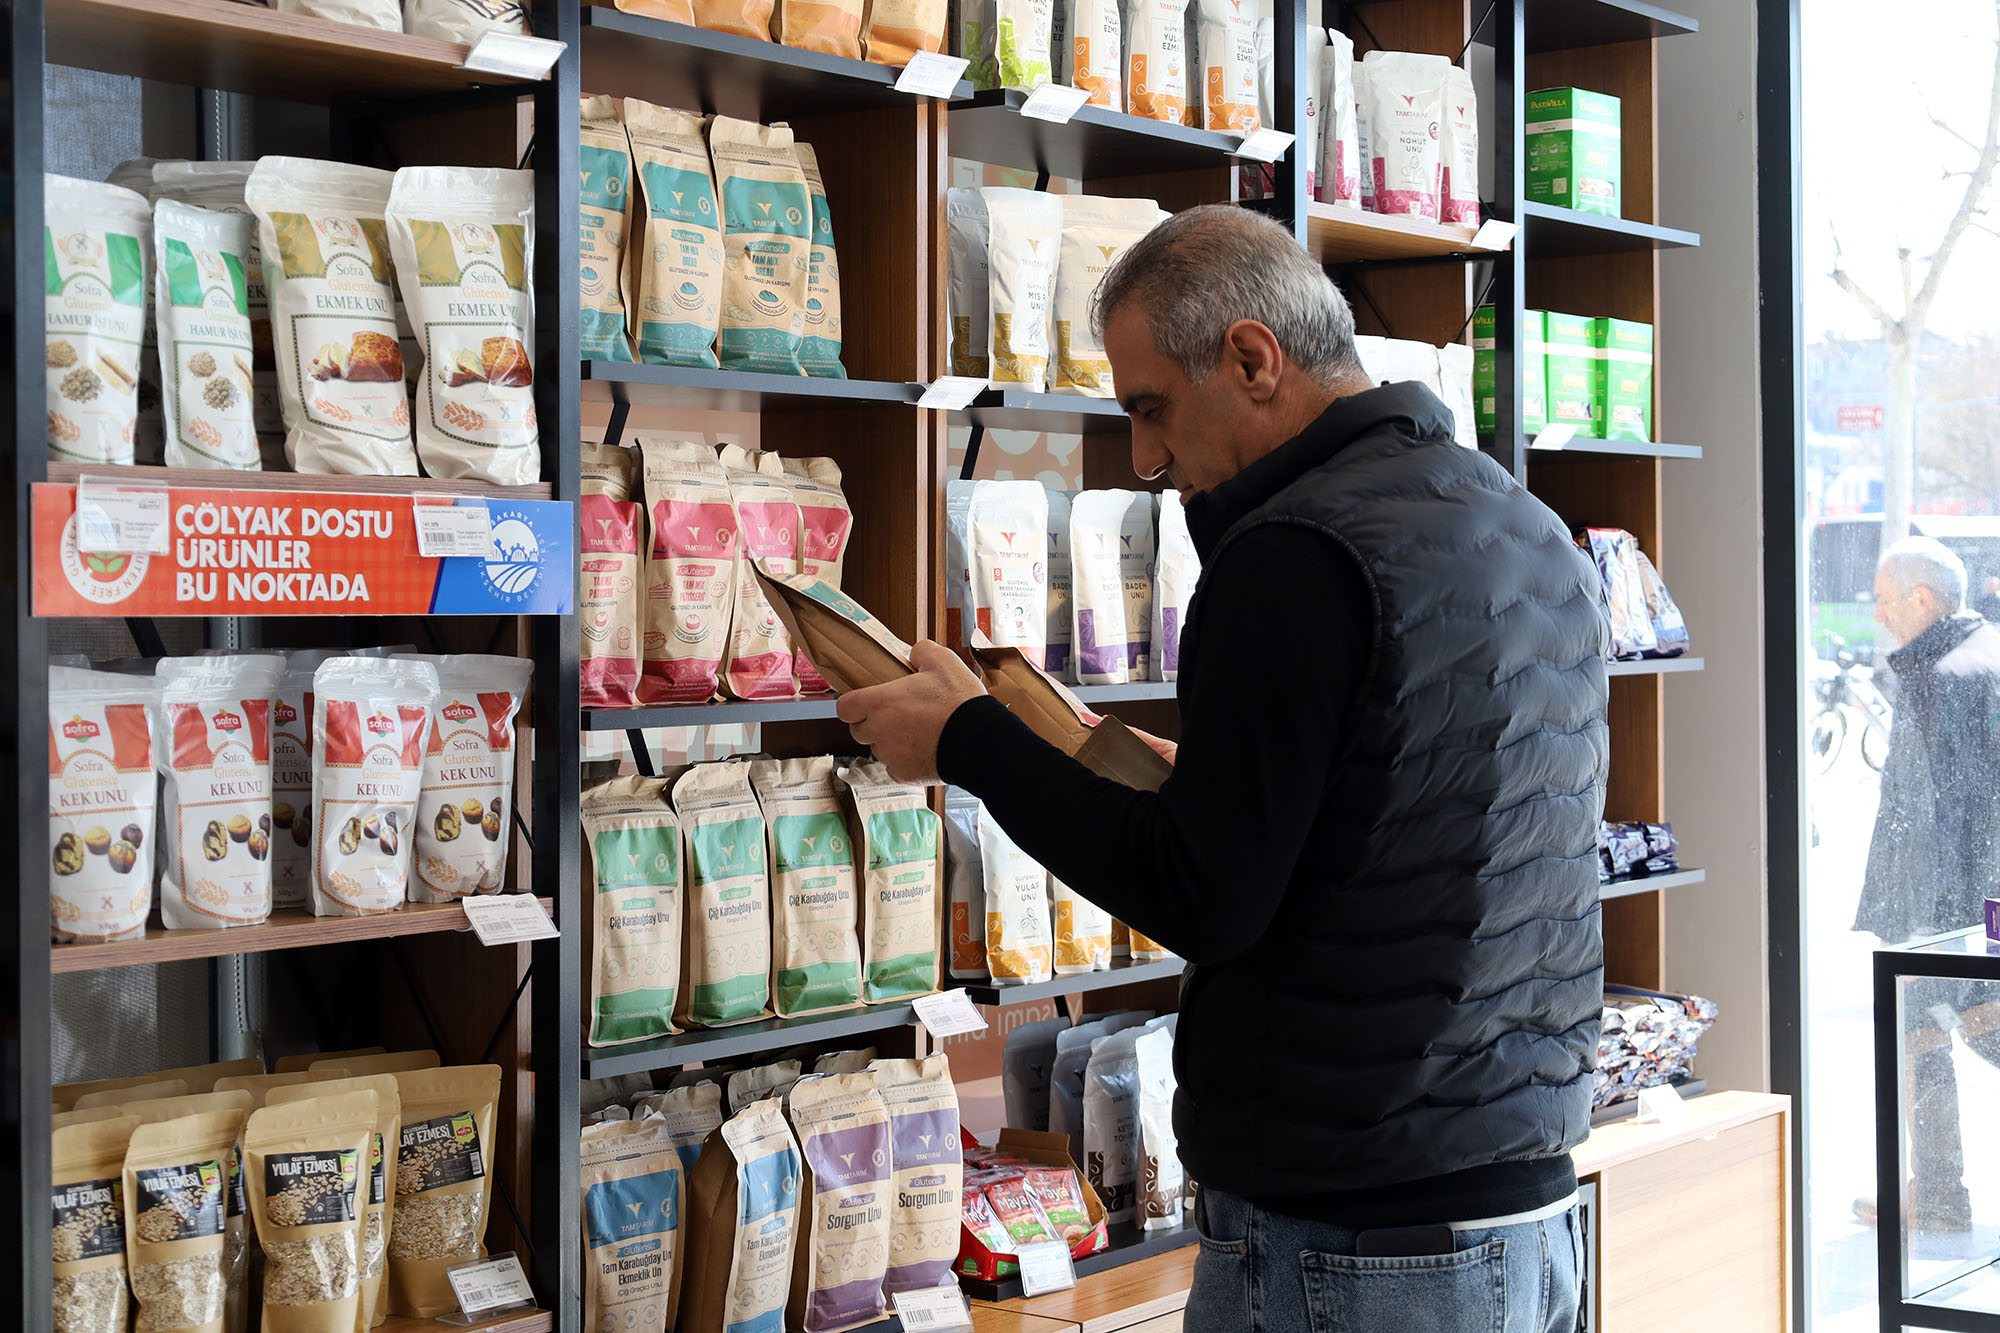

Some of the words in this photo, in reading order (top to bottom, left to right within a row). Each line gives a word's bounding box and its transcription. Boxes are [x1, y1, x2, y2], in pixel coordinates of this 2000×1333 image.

[1400, 137, 1427, 145] NOHUT
[1406, 145, 1423, 153] UNU
[336, 263, 365, 277] Sofra
[471, 271, 497, 284] Sofra
[316, 295, 364, 311] EKMEK
[367, 297, 388, 313] UNU
[448, 303, 497, 317] EKMEK
[500, 304, 519, 318] UNU
[175, 502, 293, 538] ÇÖLYAK
[301, 507, 393, 538] DOSTU
[491, 511, 534, 526] SAKARYA
[176, 538, 312, 569] ÜRÜNLER
[995, 568, 1001, 577] 6
[176, 571, 217, 602] BU
[227, 572, 370, 604] NOKTADA
[1125, 582, 1147, 590] BADEM
[1131, 591, 1145, 599] UNU
[445, 706, 473, 718] sofra
[65, 722, 96, 734] sofra
[215, 716, 240, 727] sofra
[368, 719, 393, 730] sofra
[274, 743, 296, 755] ofra
[453, 740, 479, 751] Sofra
[222, 751, 246, 764] Sofra
[372, 754, 393, 766] Sofra
[74, 759, 103, 773] Sofra
[440, 768, 467, 782] KEK
[470, 766, 496, 779] UNU
[210, 782, 236, 796] KEK
[238, 780, 263, 794] UNU
[357, 783, 379, 796] KEK
[382, 783, 403, 797] UNU
[60, 792, 91, 807] KEK
[95, 789, 128, 803] UNU
[880, 890, 891, 903] Çiğ
[891, 884, 924, 900] Karabuğday
[1015, 883, 1040, 892] YULAF
[789, 894, 800, 907] Çiğ
[801, 890, 838, 904] Karabuğday
[838, 889, 849, 900] Unu
[1020, 893, 1037, 902] UNU
[719, 902, 752, 917] Karabuğday
[609, 917, 622, 930] Çiğ
[656, 912, 670, 923] Unu
[399, 1132, 416, 1149] LAF
[416, 1123, 452, 1144] EZMESİ
[916, 1152, 942, 1161] TAMTARIM
[271, 1160, 303, 1177] YULAF
[303, 1158, 338, 1175] EZMESİ
[143, 1176, 170, 1193] YULAF
[171, 1171, 198, 1188] EZMESİ
[837, 1169, 868, 1182] TAMTARIM
[79, 1187, 112, 1205] EZMESİ
[898, 1191, 938, 1210] Sorgum
[938, 1189, 954, 1203] Unu
[1036, 1186, 1070, 1203] Maya
[996, 1194, 1028, 1212] Maya
[827, 1211, 866, 1230] Sorgum
[867, 1206, 882, 1223] Unu
[620, 1220, 655, 1232] TAMTARIM
[747, 1239, 760, 1251] Tam
[602, 1262, 617, 1275] Tam
[618, 1252, 662, 1272] Karabuğday
[618, 1267, 651, 1286] Ekmeklik
[652, 1266, 663, 1279] Un
